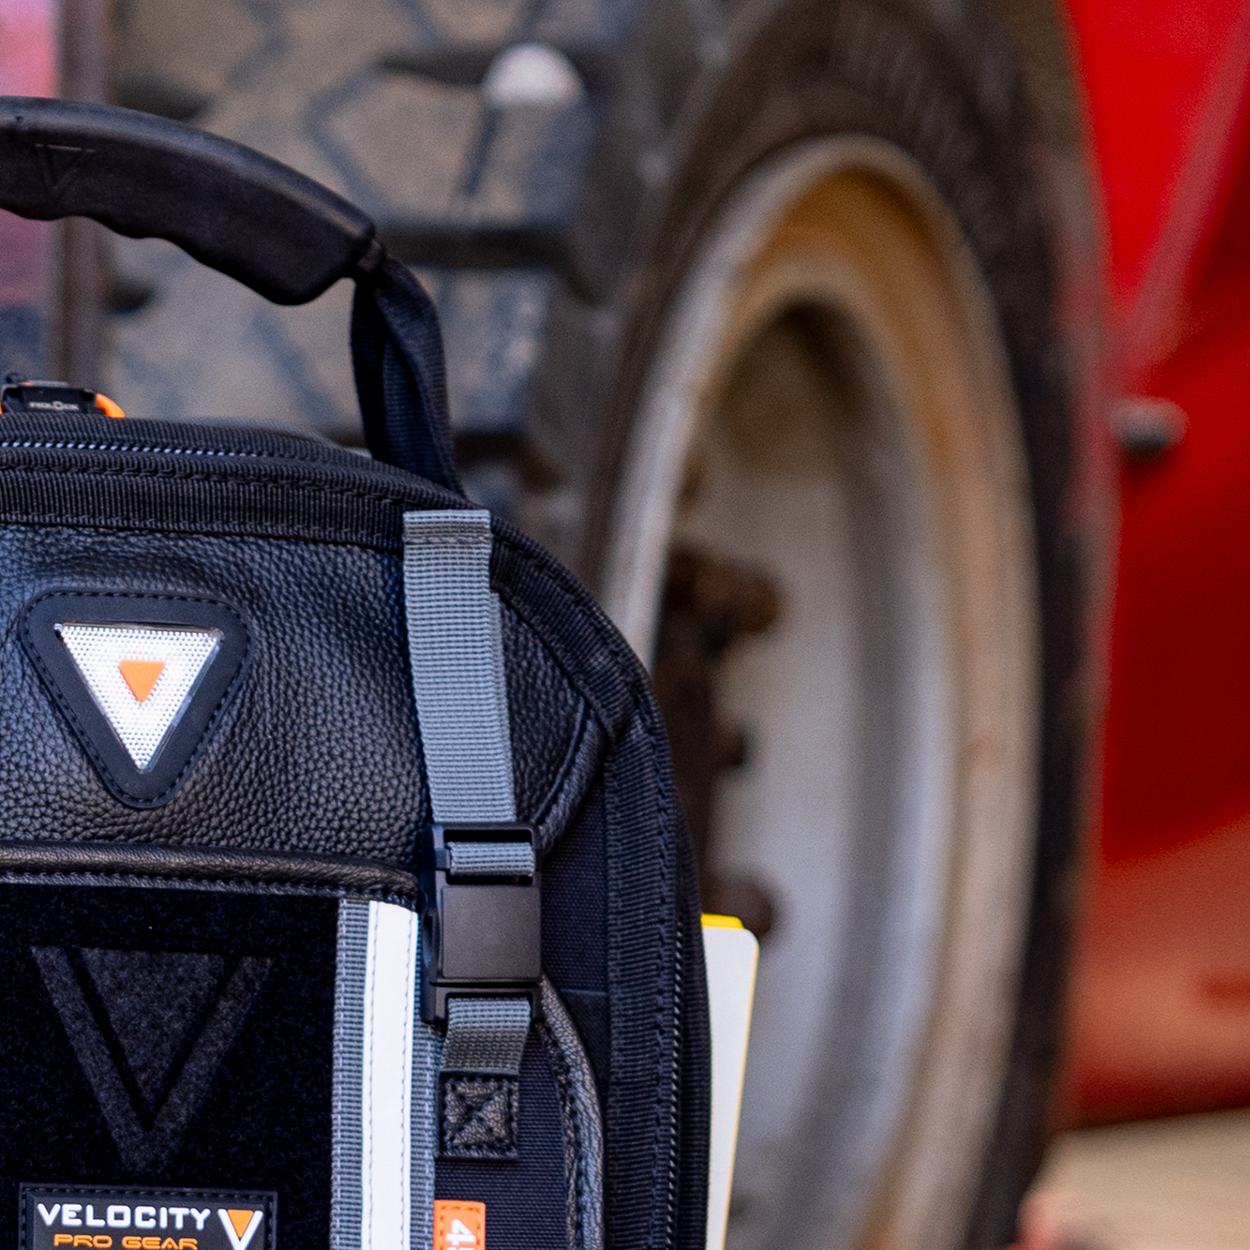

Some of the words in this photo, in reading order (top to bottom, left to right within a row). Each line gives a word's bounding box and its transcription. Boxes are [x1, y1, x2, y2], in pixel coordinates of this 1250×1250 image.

[37, 1203, 211, 1231] VELOCITY
[54, 1233, 113, 1249] PRO
[121, 1235, 198, 1250] GEAR
